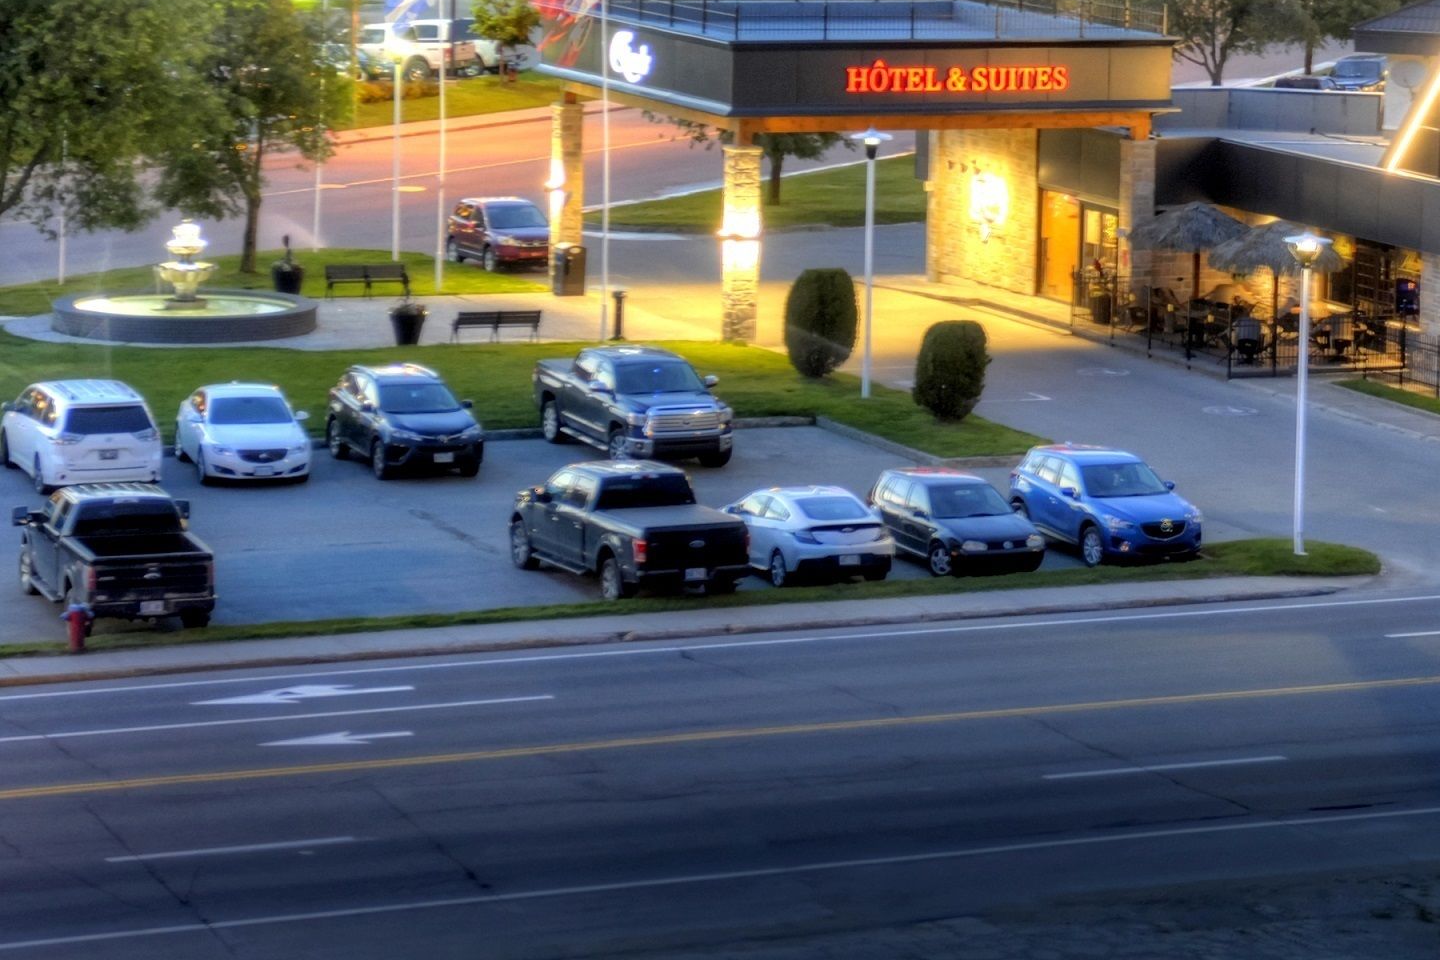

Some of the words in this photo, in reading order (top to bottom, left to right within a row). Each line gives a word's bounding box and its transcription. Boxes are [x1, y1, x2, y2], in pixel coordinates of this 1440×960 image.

[846, 59, 942, 92] HÔTEL
[946, 67, 967, 92] &
[971, 66, 1068, 92] SUITES
